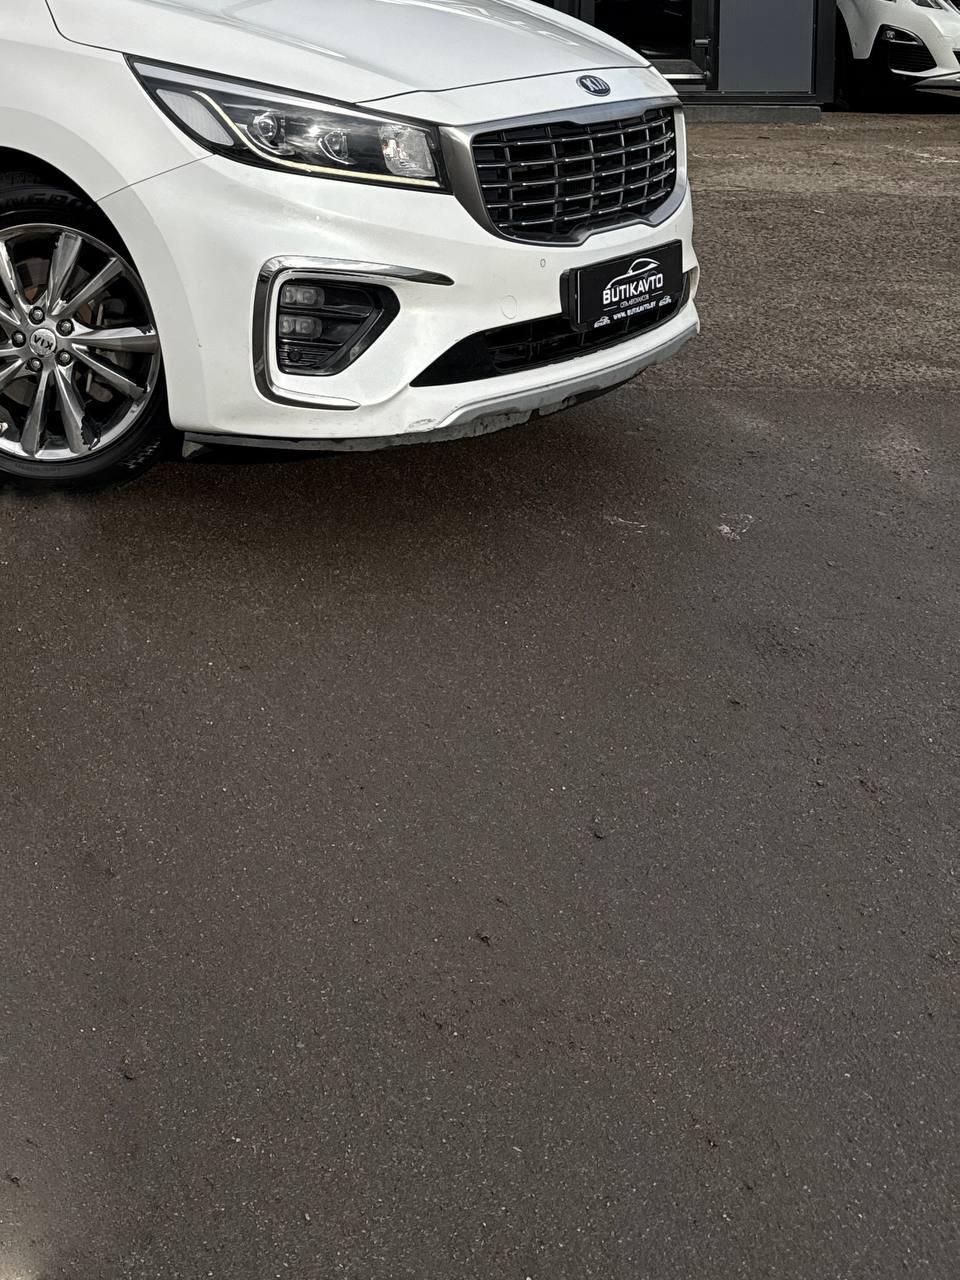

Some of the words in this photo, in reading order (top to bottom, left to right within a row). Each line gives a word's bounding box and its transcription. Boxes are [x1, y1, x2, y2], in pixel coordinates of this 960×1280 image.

[581, 78, 609, 91] KIA
[603, 273, 663, 305] BUTIKAVTO
[34, 334, 53, 351] KIA
